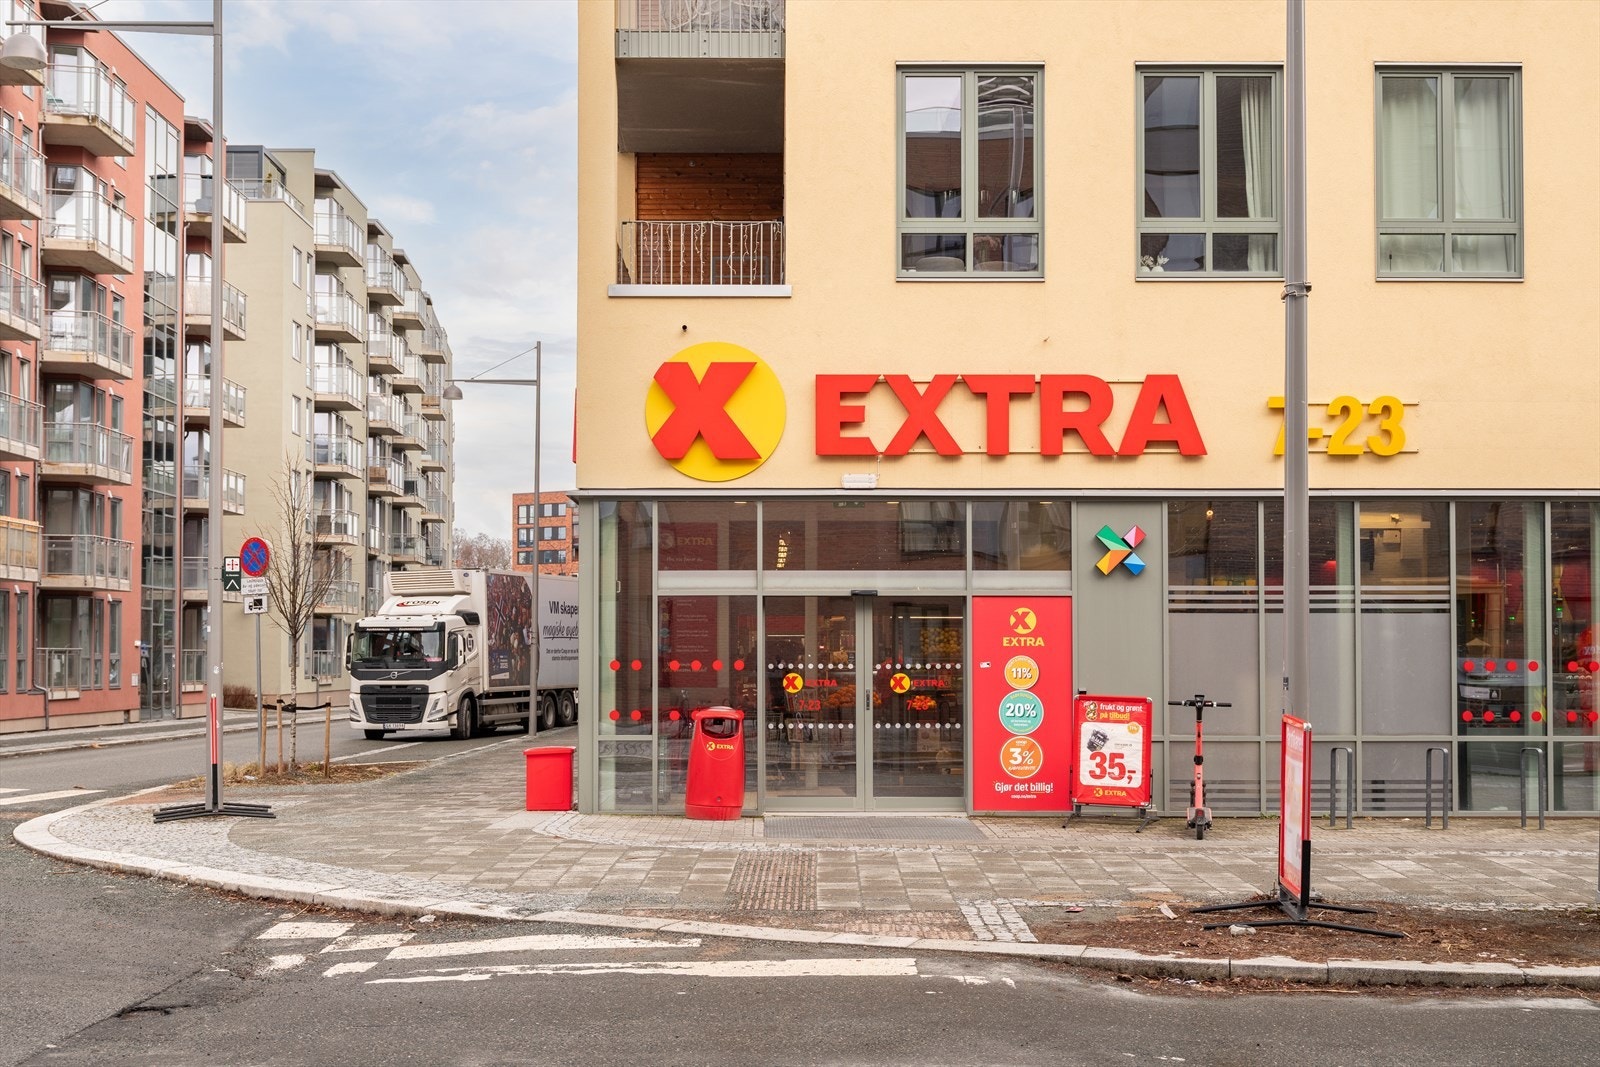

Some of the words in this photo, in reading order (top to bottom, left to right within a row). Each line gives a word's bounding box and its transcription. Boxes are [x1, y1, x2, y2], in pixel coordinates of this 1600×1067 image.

[814, 373, 1208, 457] EXTRA
[677, 537, 713, 546] EXTRA
[548, 600, 560, 614] VM
[1002, 636, 1045, 647] EXTRA
[1012, 668, 1032, 679] 11%
[800, 700, 821, 711] 7-23
[1005, 703, 1037, 718] 20%
[1100, 712, 1108, 720] på
[1009, 746, 1035, 765] 3%
[1088, 752, 1136, 784] 35,-
[994, 782, 1012, 794] Gjør
[1014, 782, 1028, 792] det
[1030, 782, 1054, 794] billig!
